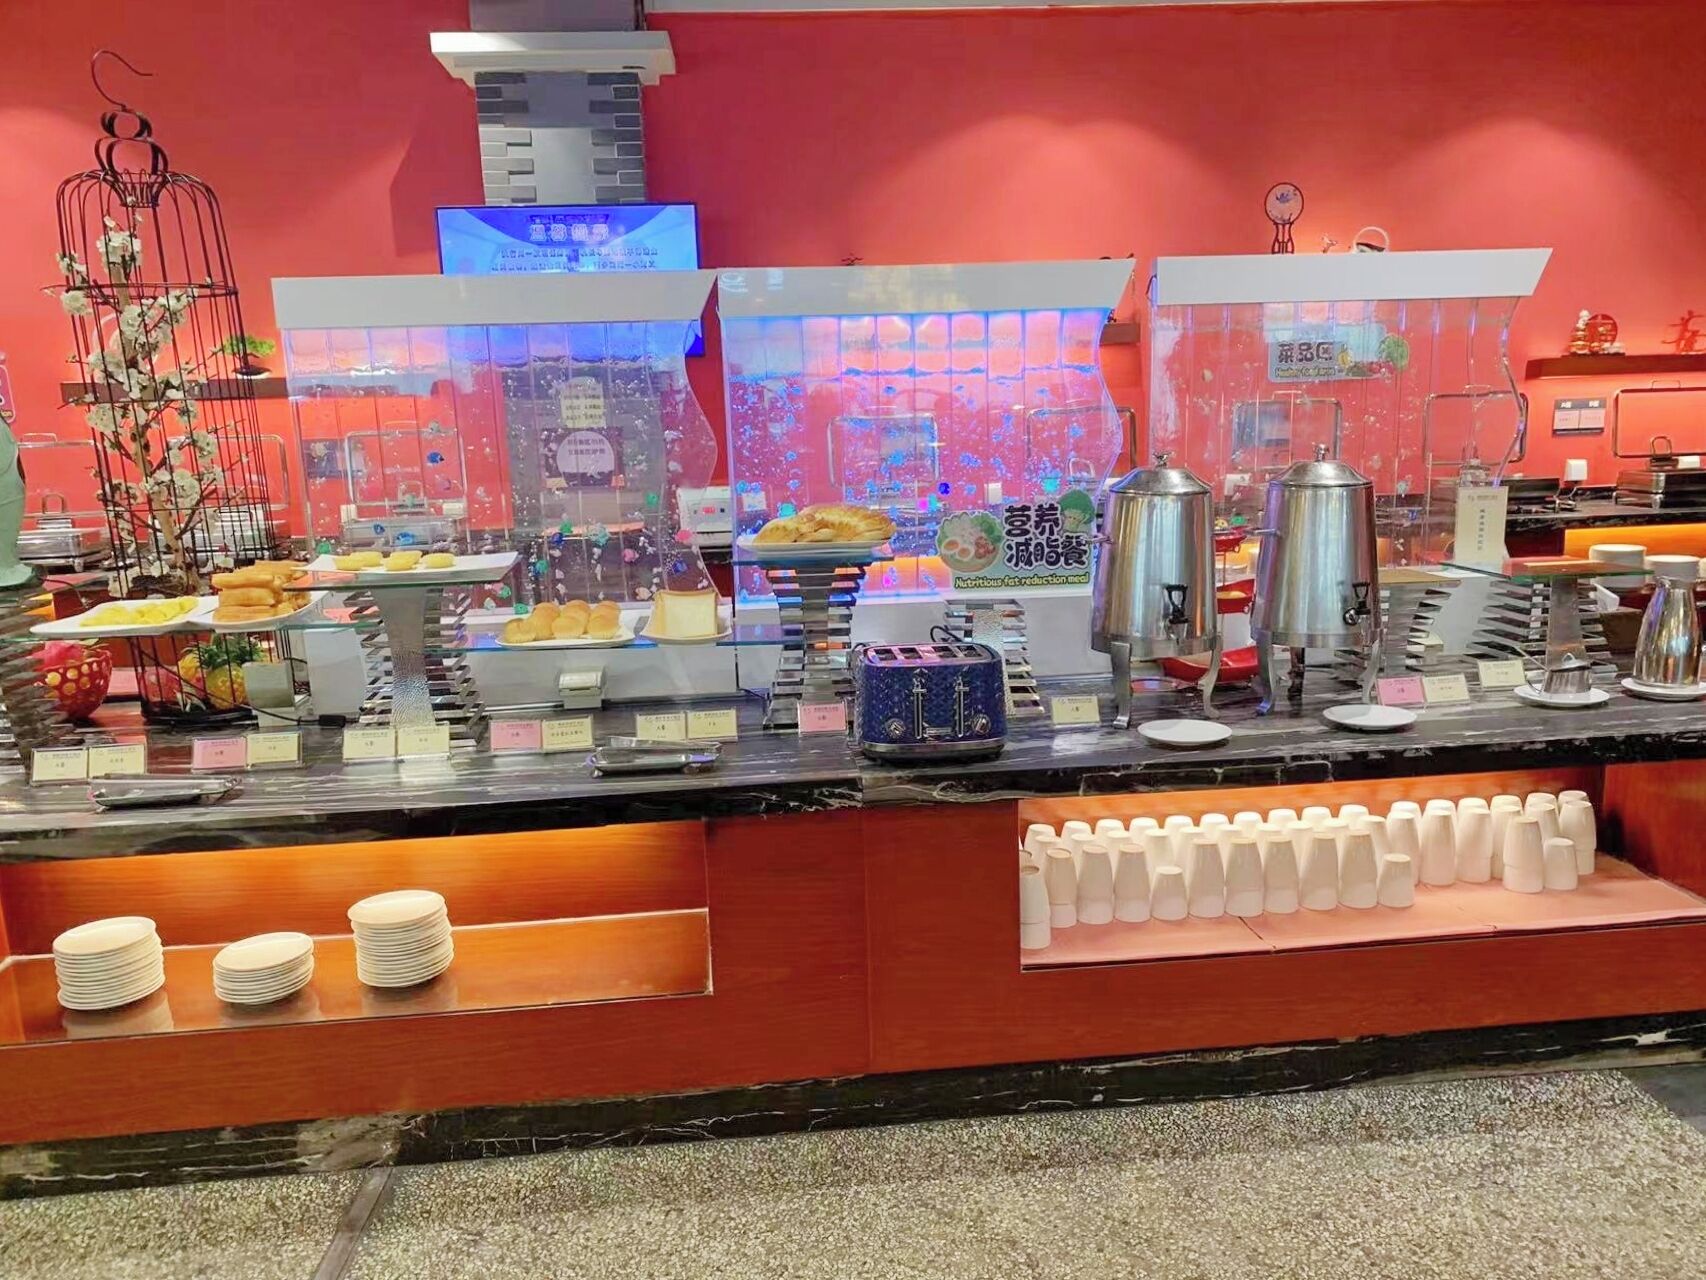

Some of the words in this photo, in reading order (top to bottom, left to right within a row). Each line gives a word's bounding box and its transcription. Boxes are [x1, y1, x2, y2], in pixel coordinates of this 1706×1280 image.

[1004, 503, 1060, 537] 营养
[1005, 536, 1088, 568] 减脂餐
[955, 577, 1002, 588] Nutritious
[1004, 575, 1020, 587] fat
[1021, 574, 1066, 586] reduction
[1068, 572, 1089, 584] meal
